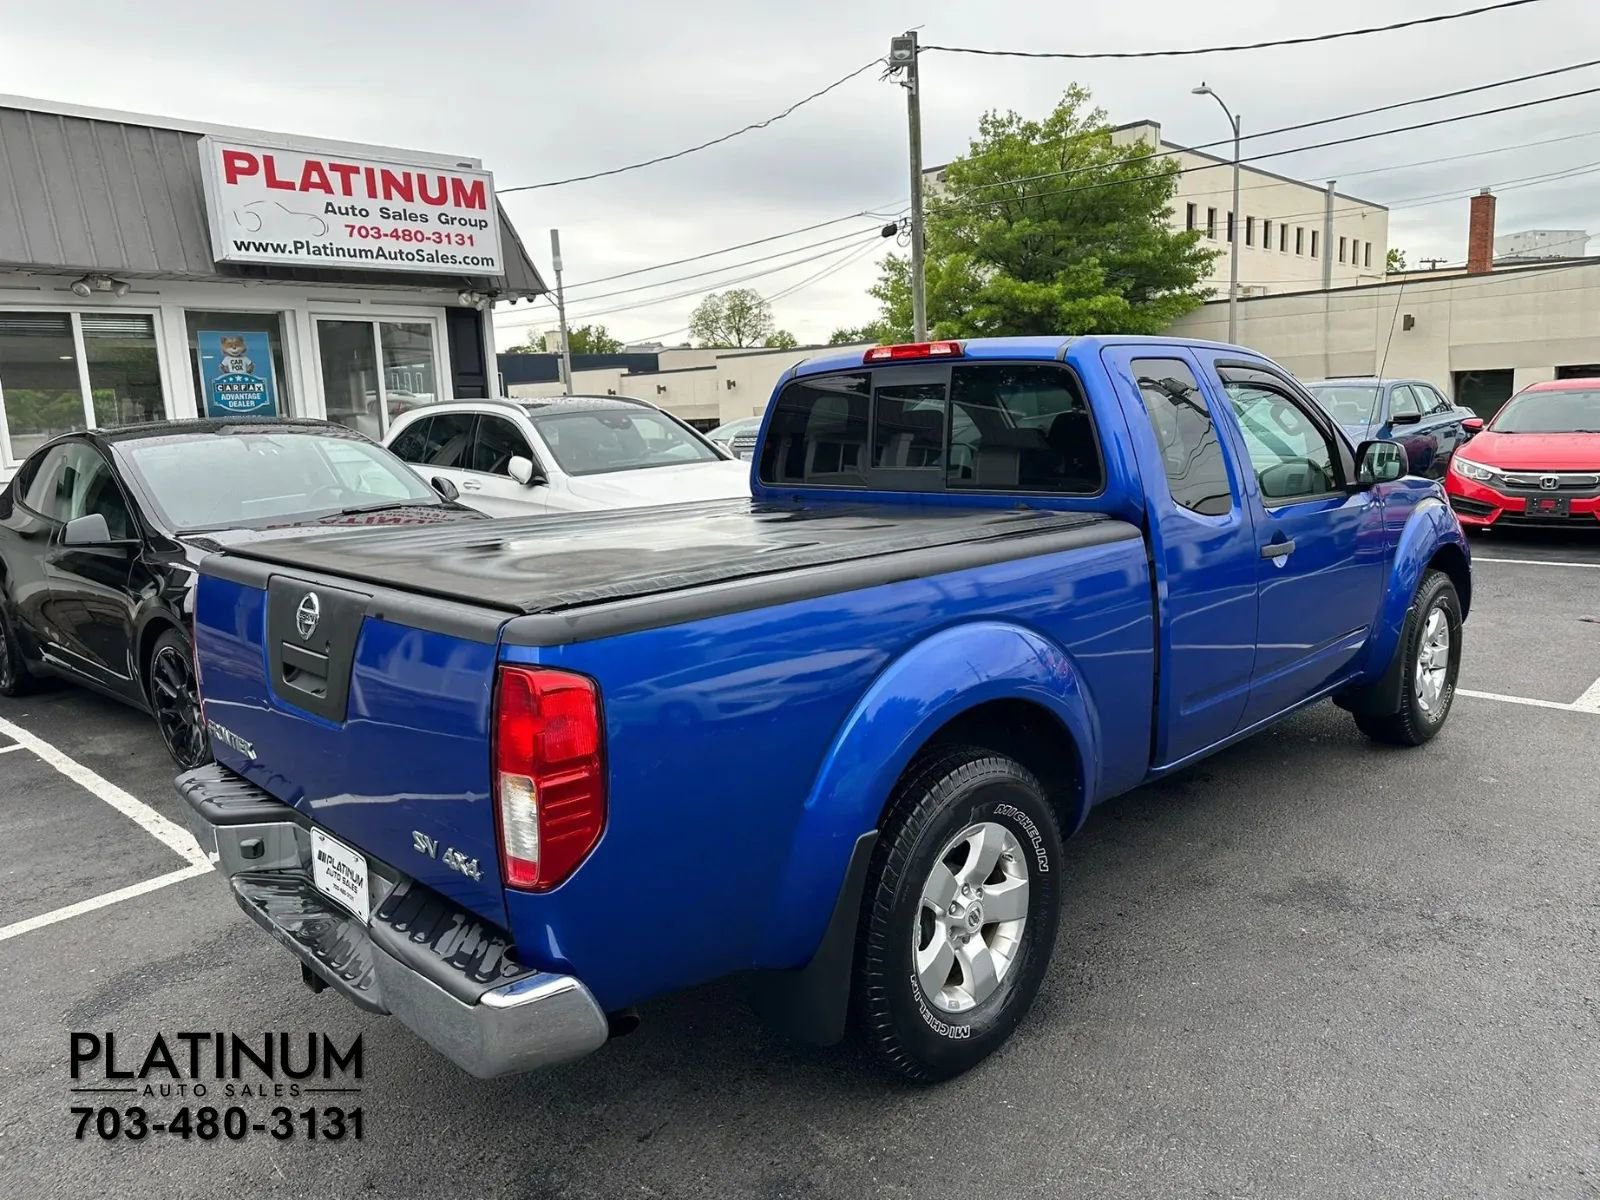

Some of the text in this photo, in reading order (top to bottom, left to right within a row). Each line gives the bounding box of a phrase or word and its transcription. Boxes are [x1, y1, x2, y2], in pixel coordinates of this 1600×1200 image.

[222, 149, 488, 211] PLATINUM
[323, 202, 489, 230] Auto Sales Group
[344, 224, 476, 247] 703-480-3131
[233, 238, 495, 268] www.PlatinumAutoSales.com
[216, 383, 264, 392] CARFAX
[228, 400, 255, 408] DEALER
[412, 830, 439, 859] SV
[993, 803, 1049, 872] MICHELIN
[326, 867, 341, 881] AUTO
[342, 876, 358, 894] SALES
[327, 854, 364, 888] PLATINUM
[910, 974, 971, 1039] MICHELIN
